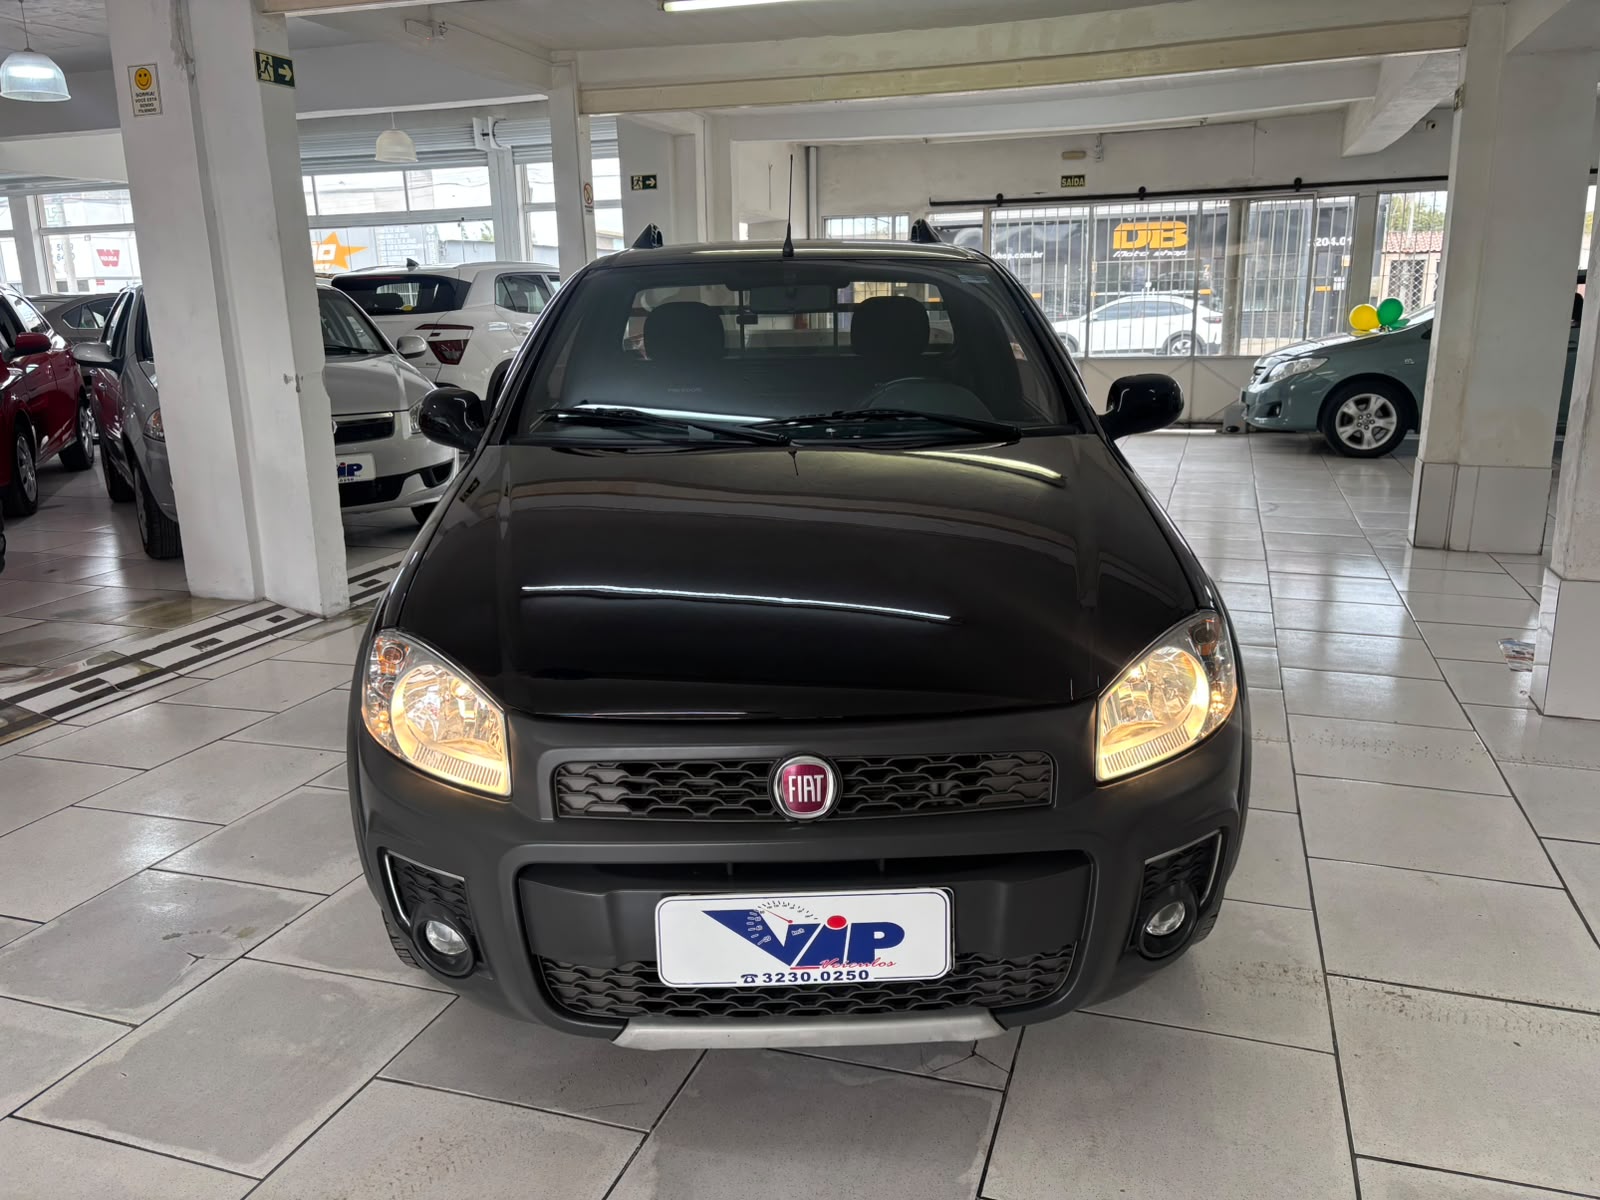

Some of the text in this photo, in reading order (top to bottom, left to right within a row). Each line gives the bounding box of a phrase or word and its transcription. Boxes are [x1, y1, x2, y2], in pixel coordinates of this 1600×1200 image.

[1061, 176, 1084, 187] SAÍDA
[1113, 221, 1189, 250] DB
[788, 774, 824, 803] FIAT
[762, 970, 870, 984] 3230.0250
